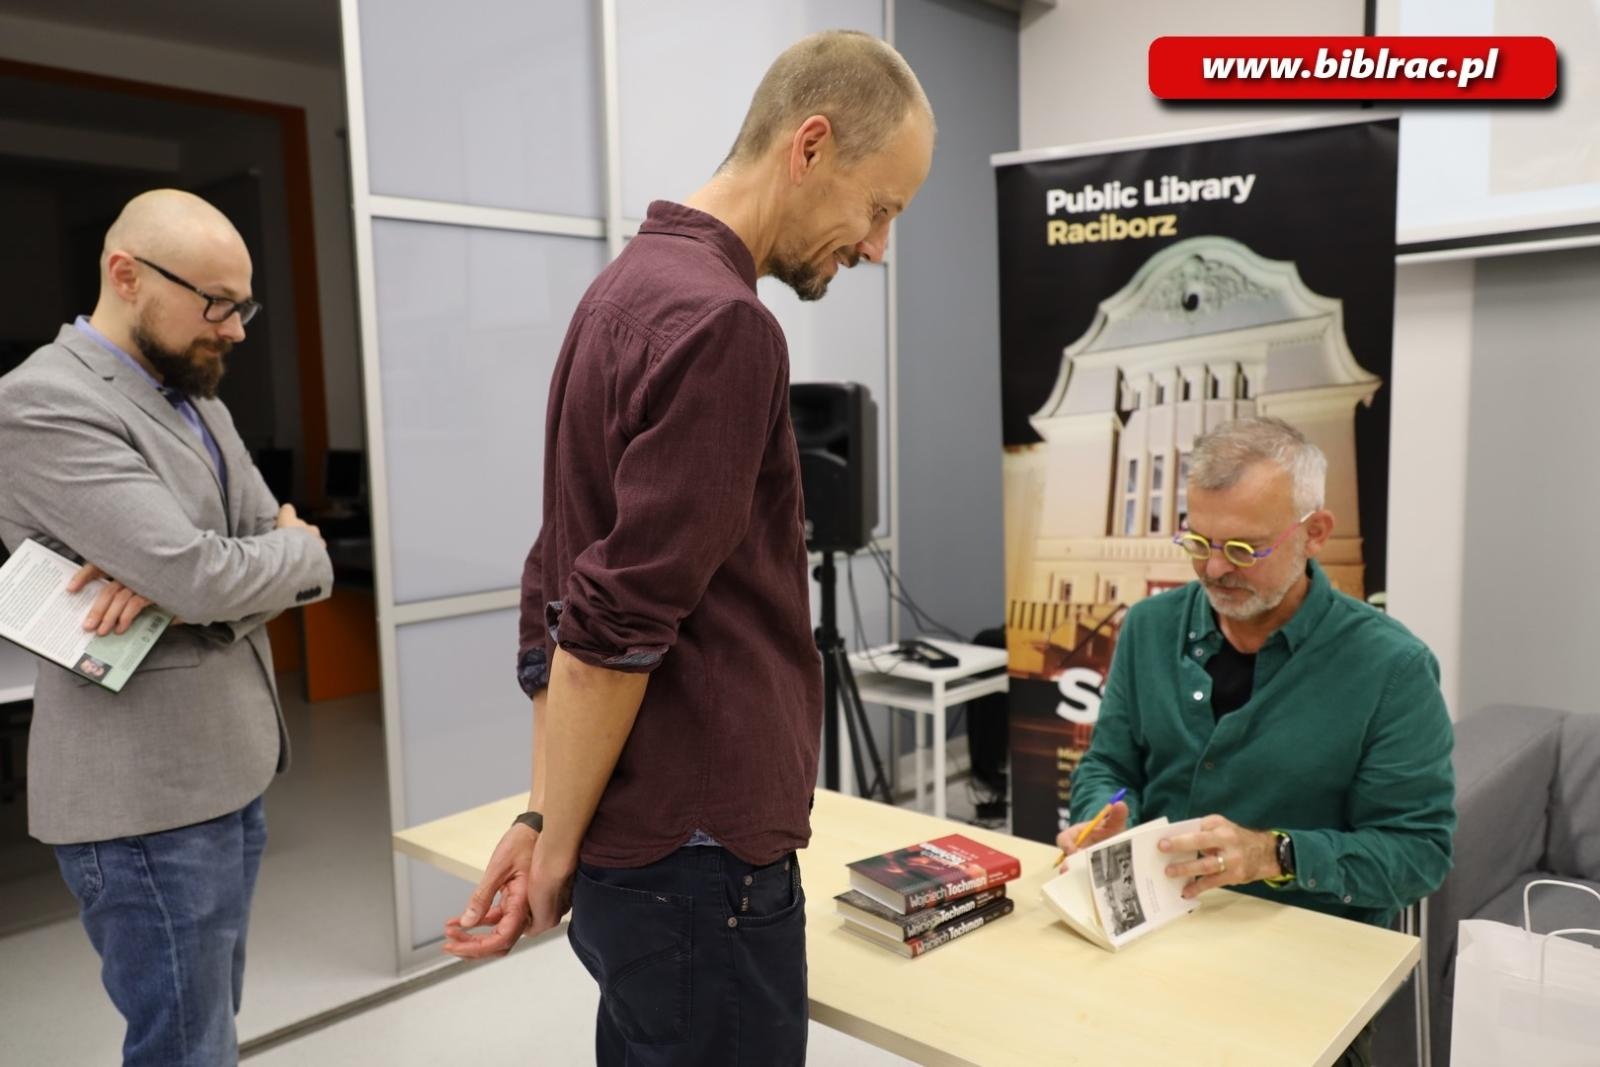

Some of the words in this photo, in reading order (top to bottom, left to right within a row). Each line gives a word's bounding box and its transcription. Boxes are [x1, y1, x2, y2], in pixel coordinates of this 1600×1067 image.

[1046, 184, 1139, 216] Public
[1143, 173, 1256, 208] Library
[1047, 213, 1178, 247] Raciborz
[1056, 667, 1105, 725] S
[946, 876, 987, 895] Tochman
[939, 900, 976, 920] Tochman
[948, 916, 984, 939] Tochman
